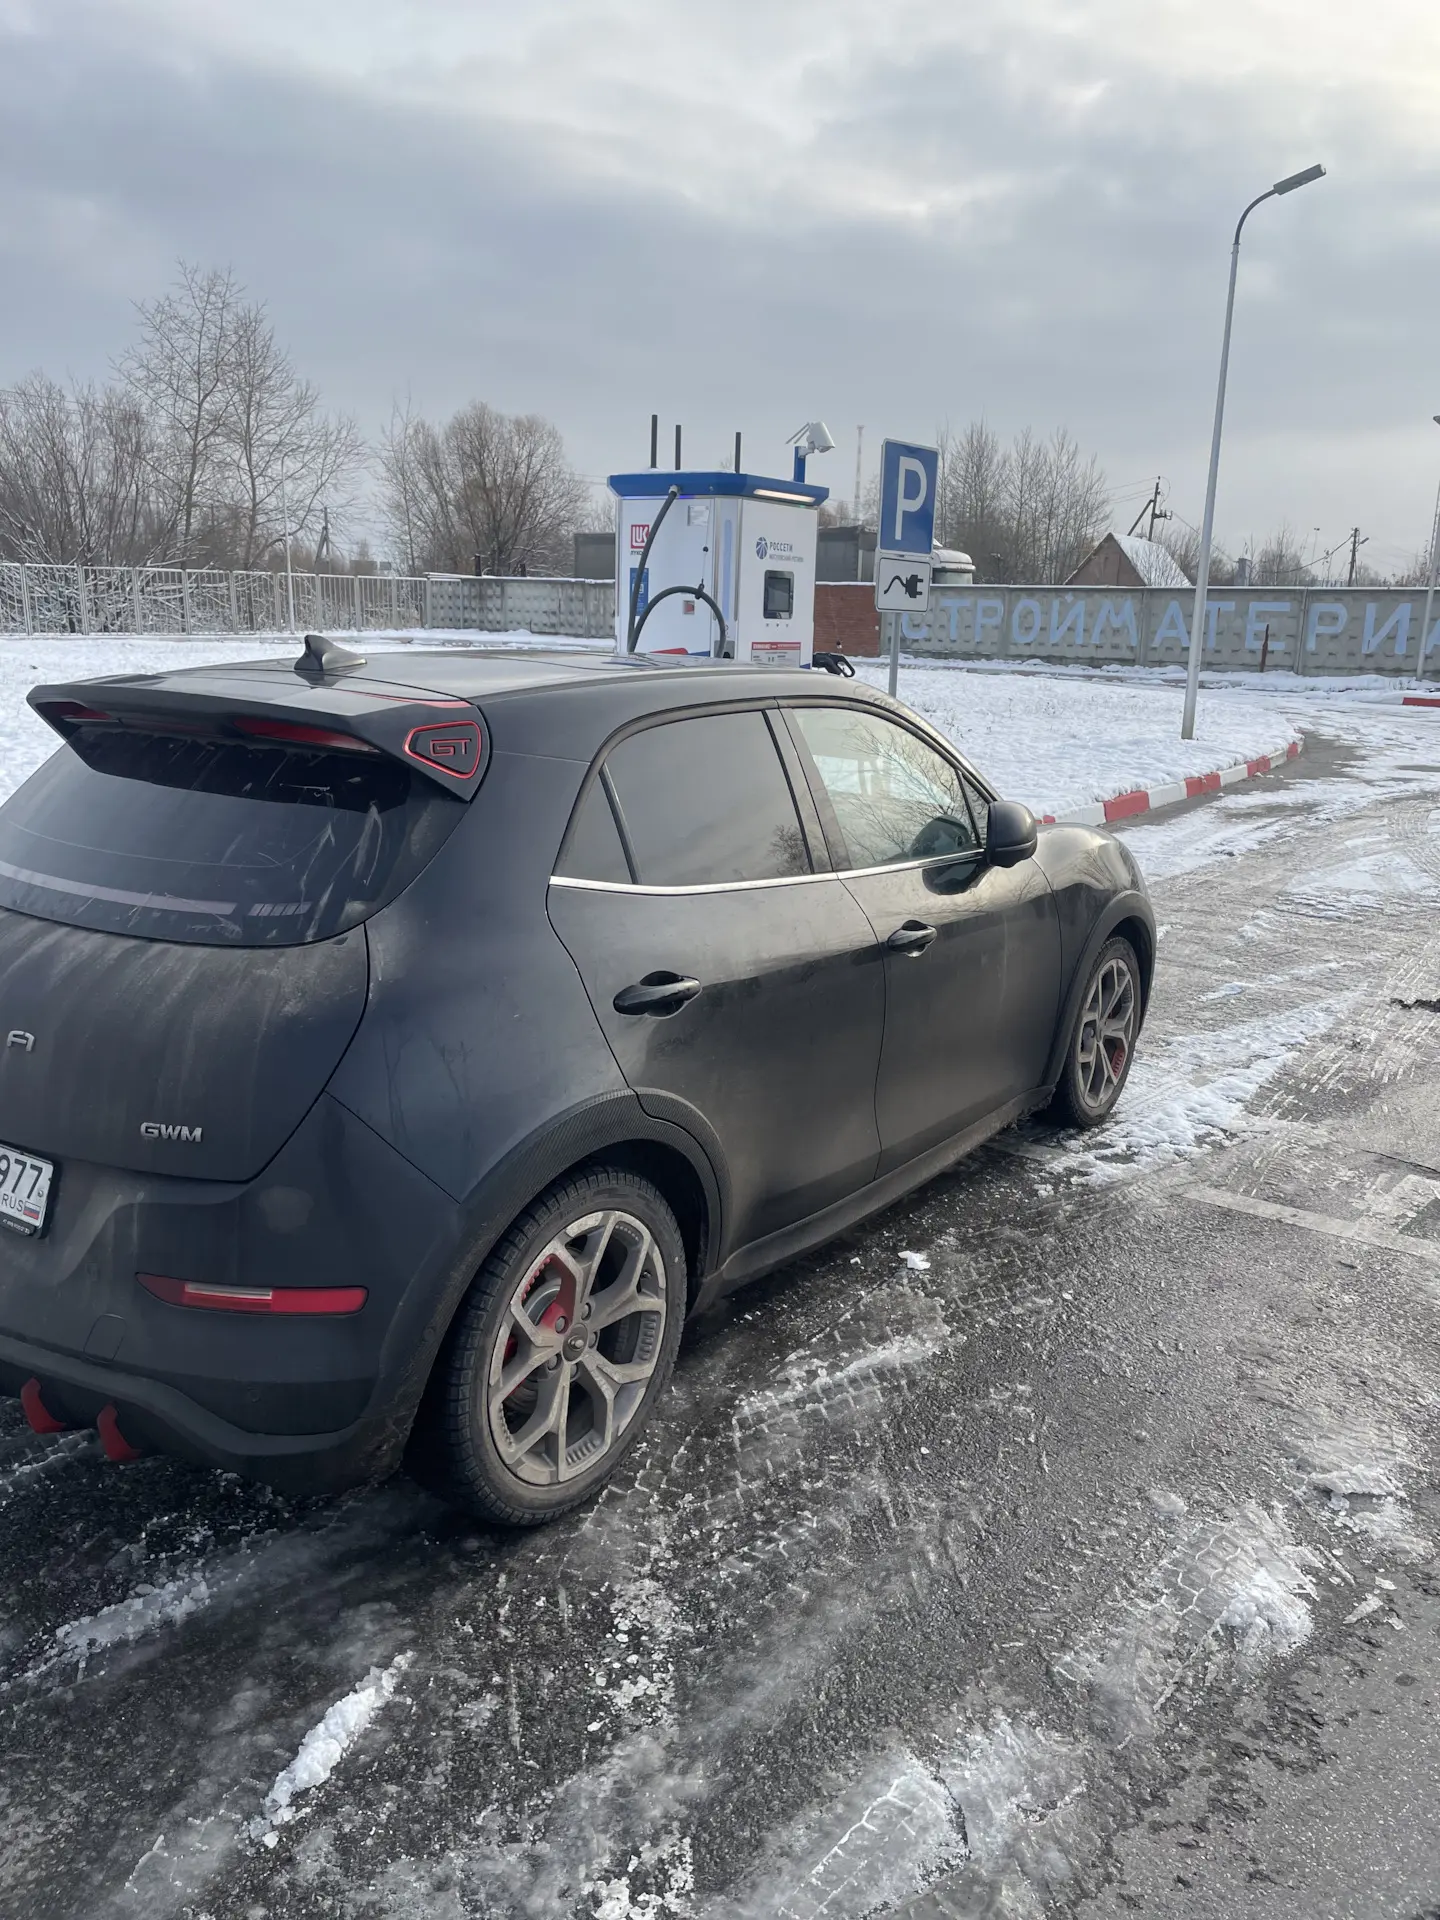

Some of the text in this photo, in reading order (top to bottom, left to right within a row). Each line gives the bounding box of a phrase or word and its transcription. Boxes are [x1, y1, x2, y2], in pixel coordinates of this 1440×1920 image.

[895, 456, 927, 540] P
[769, 541, 793, 552] РОССЕТИ
[430, 738, 471, 756] GT
[140, 1122, 202, 1143] GWM
[1, 1193, 24, 1212] RUS
